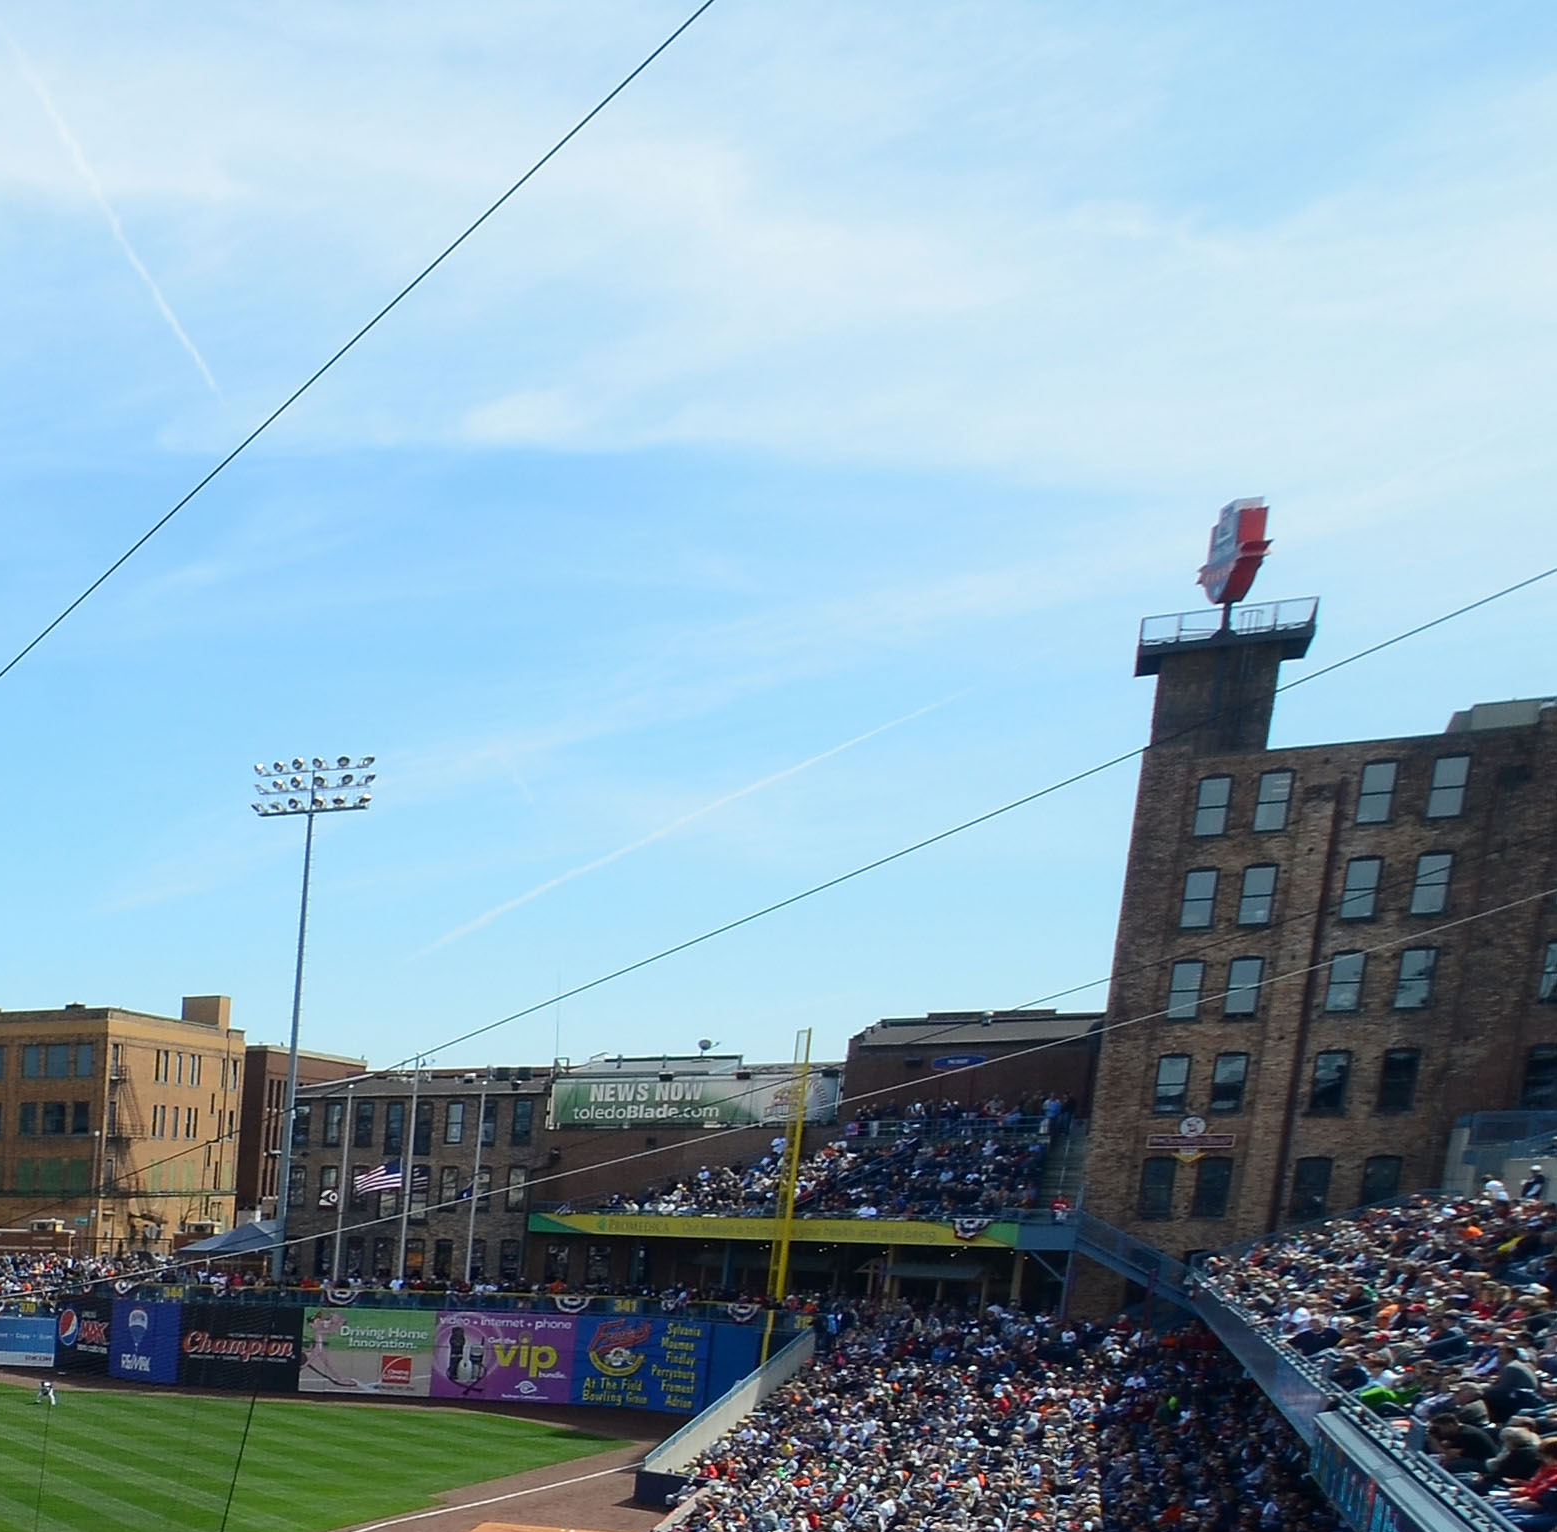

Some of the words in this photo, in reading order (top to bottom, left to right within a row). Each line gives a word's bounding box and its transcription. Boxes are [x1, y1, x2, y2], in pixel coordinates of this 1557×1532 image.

[589, 1083, 650, 1102] NEWS
[654, 1082, 704, 1101] NOW
[573, 1103, 719, 1120] toledoBlade.com
[682, 1223, 700, 1233] Our
[703, 1223, 735, 1234] Mission
[825, 1226, 853, 1237] health
[858, 1227, 880, 1238] and
[614, 1300, 637, 1312] 341
[439, 1317, 470, 1325] video
[481, 1318, 524, 1328] internet
[535, 1319, 572, 1330] phone
[667, 1323, 701, 1337] Sylvania
[78, 1320, 110, 1344] MAX
[340, 1326, 385, 1340] Driving
[388, 1328, 428, 1339] Home
[183, 1331, 293, 1362] Champion
[349, 1338, 417, 1349] Innovation.
[661, 1337, 694, 1351] Maumee
[494, 1338, 558, 1378] vip
[666, 1351, 695, 1368] Findlay
[651, 1364, 696, 1383] Perrysburg
[583, 1377, 595, 1388] At
[601, 1378, 617, 1389] The
[622, 1379, 642, 1391] Field
[661, 1380, 694, 1394] Fremont
[583, 1390, 622, 1406] Bowling
[665, 1395, 692, 1408] Adrian
